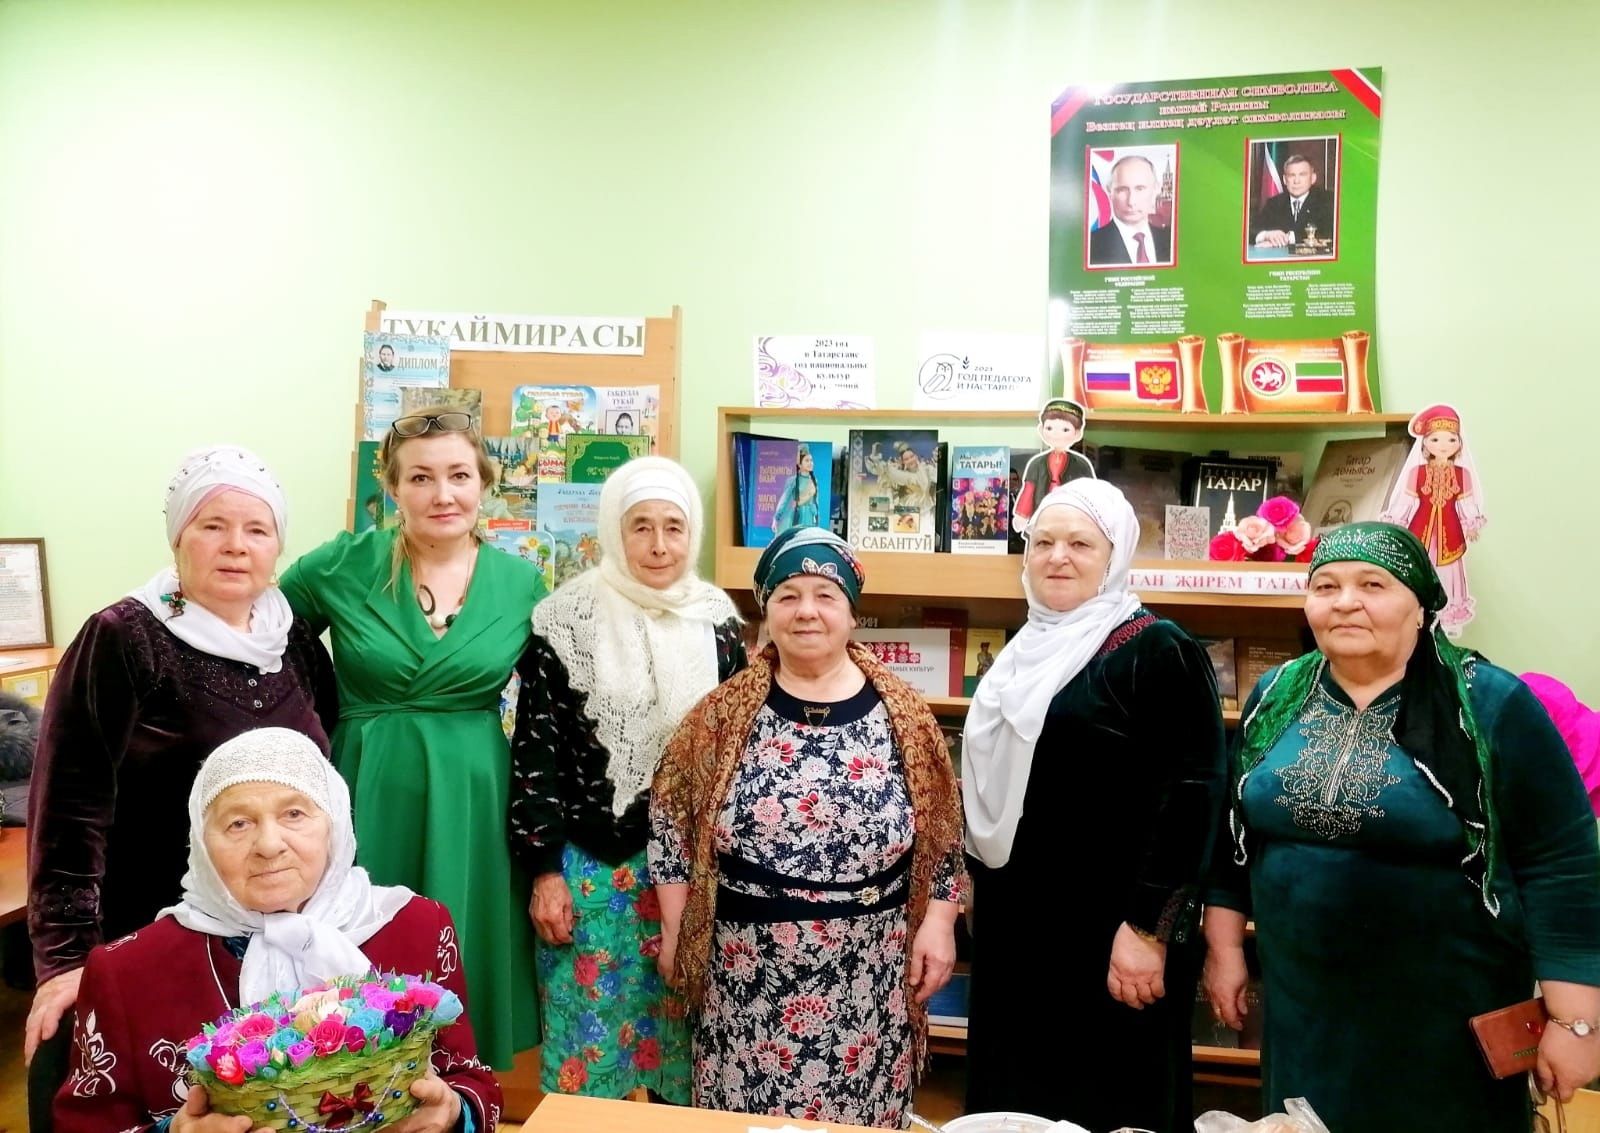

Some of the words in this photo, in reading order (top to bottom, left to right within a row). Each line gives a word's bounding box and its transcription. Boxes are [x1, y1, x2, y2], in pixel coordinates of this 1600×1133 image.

[1094, 88, 1239, 106] ГОСУДАРСТВЕННАЯ
[1241, 81, 1338, 97] СИМВОЛИКА
[398, 356, 438, 371] ДИПЛОМ
[958, 373, 977, 381] ГОД
[980, 374, 1031, 383] ПЕДАГОГА
[959, 461, 1002, 470] ТАТАРЫ!
[1205, 475, 1262, 492] ТАТАР
[862, 534, 932, 551] САБАНТУЙ
[1129, 574, 1165, 586] ГАН
